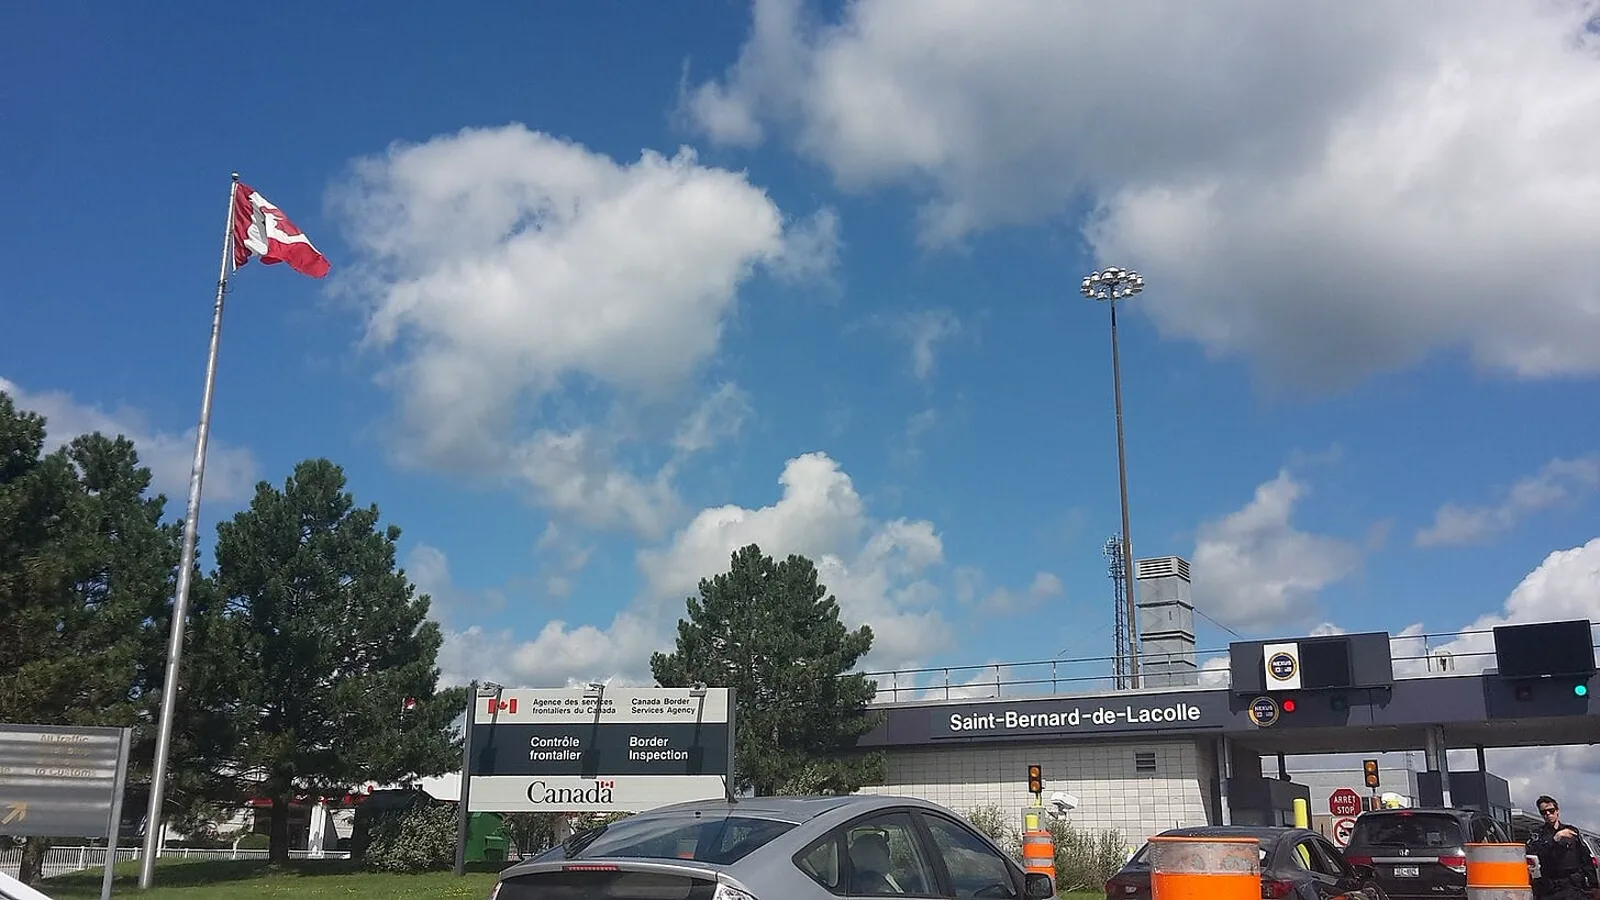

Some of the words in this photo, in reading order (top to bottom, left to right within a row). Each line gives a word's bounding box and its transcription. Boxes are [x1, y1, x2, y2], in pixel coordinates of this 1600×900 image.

[532, 699, 561, 707] Agence
[564, 698, 578, 706] des
[631, 697, 661, 705] Canada
[667, 707, 695, 715] Agency
[950, 703, 1201, 731] Saint-Bernard-de-Lacolle
[530, 736, 580, 748] Contrôle
[629, 737, 669, 747] Border
[530, 750, 582, 761] frontalier
[629, 750, 689, 763] Inspection
[527, 781, 613, 804] Canada
[1336, 806, 1355, 814] STOP
